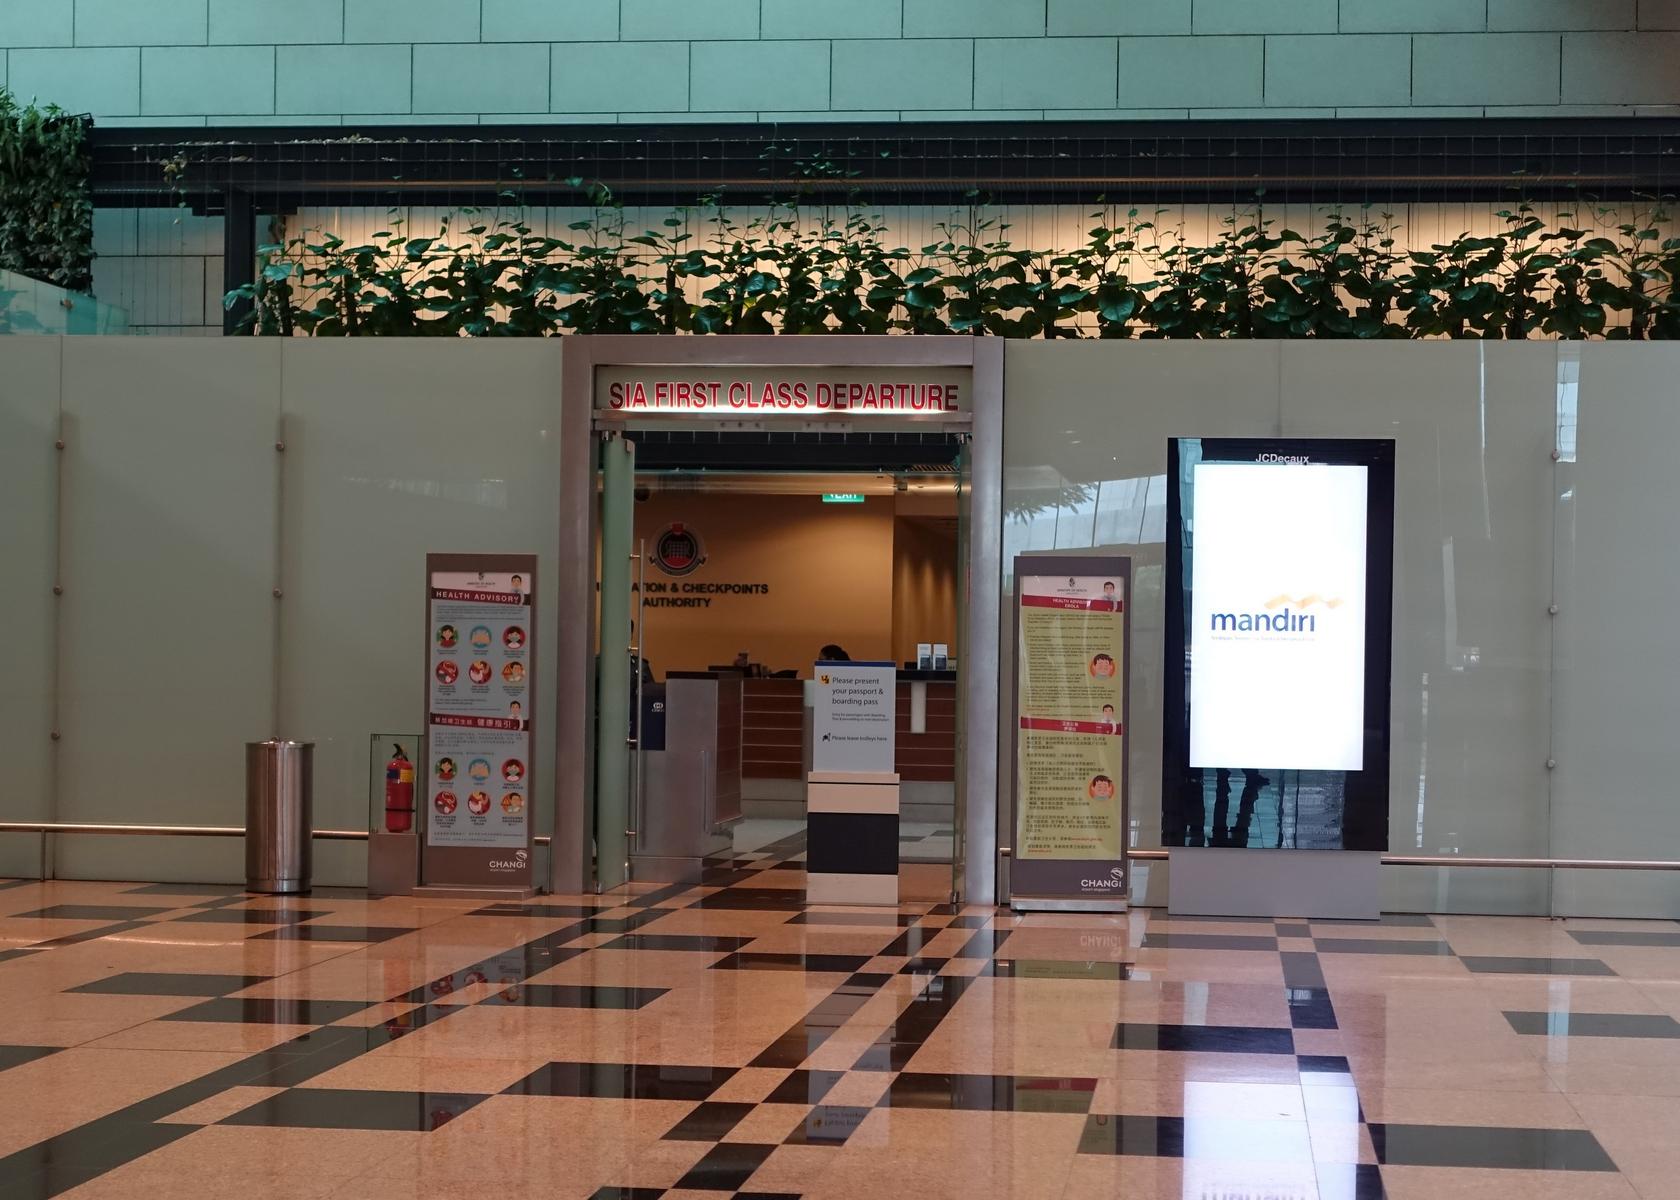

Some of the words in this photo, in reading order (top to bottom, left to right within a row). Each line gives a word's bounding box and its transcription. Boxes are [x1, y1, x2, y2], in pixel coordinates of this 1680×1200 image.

[609, 382, 648, 409] SIA
[655, 382, 721, 409] FIRST
[728, 382, 808, 409] CLASS
[816, 383, 959, 410] DEPARTURE
[1255, 453, 1309, 463] JCDecaux
[670, 583, 679, 593] &
[682, 583, 768, 594] CHECKPOINTS
[436, 591, 470, 600] HEALTH
[474, 593, 519, 603] ADVISORY
[643, 597, 711, 608] AUTHORITY
[1211, 608, 1315, 632] mandiri
[832, 677, 854, 685] Please
[854, 678, 879, 686] present
[849, 688, 877, 696] passport
[832, 698, 862, 706] boarding
[489, 860, 526, 869] CHANGI
[1080, 879, 1122, 888] CHANGI
